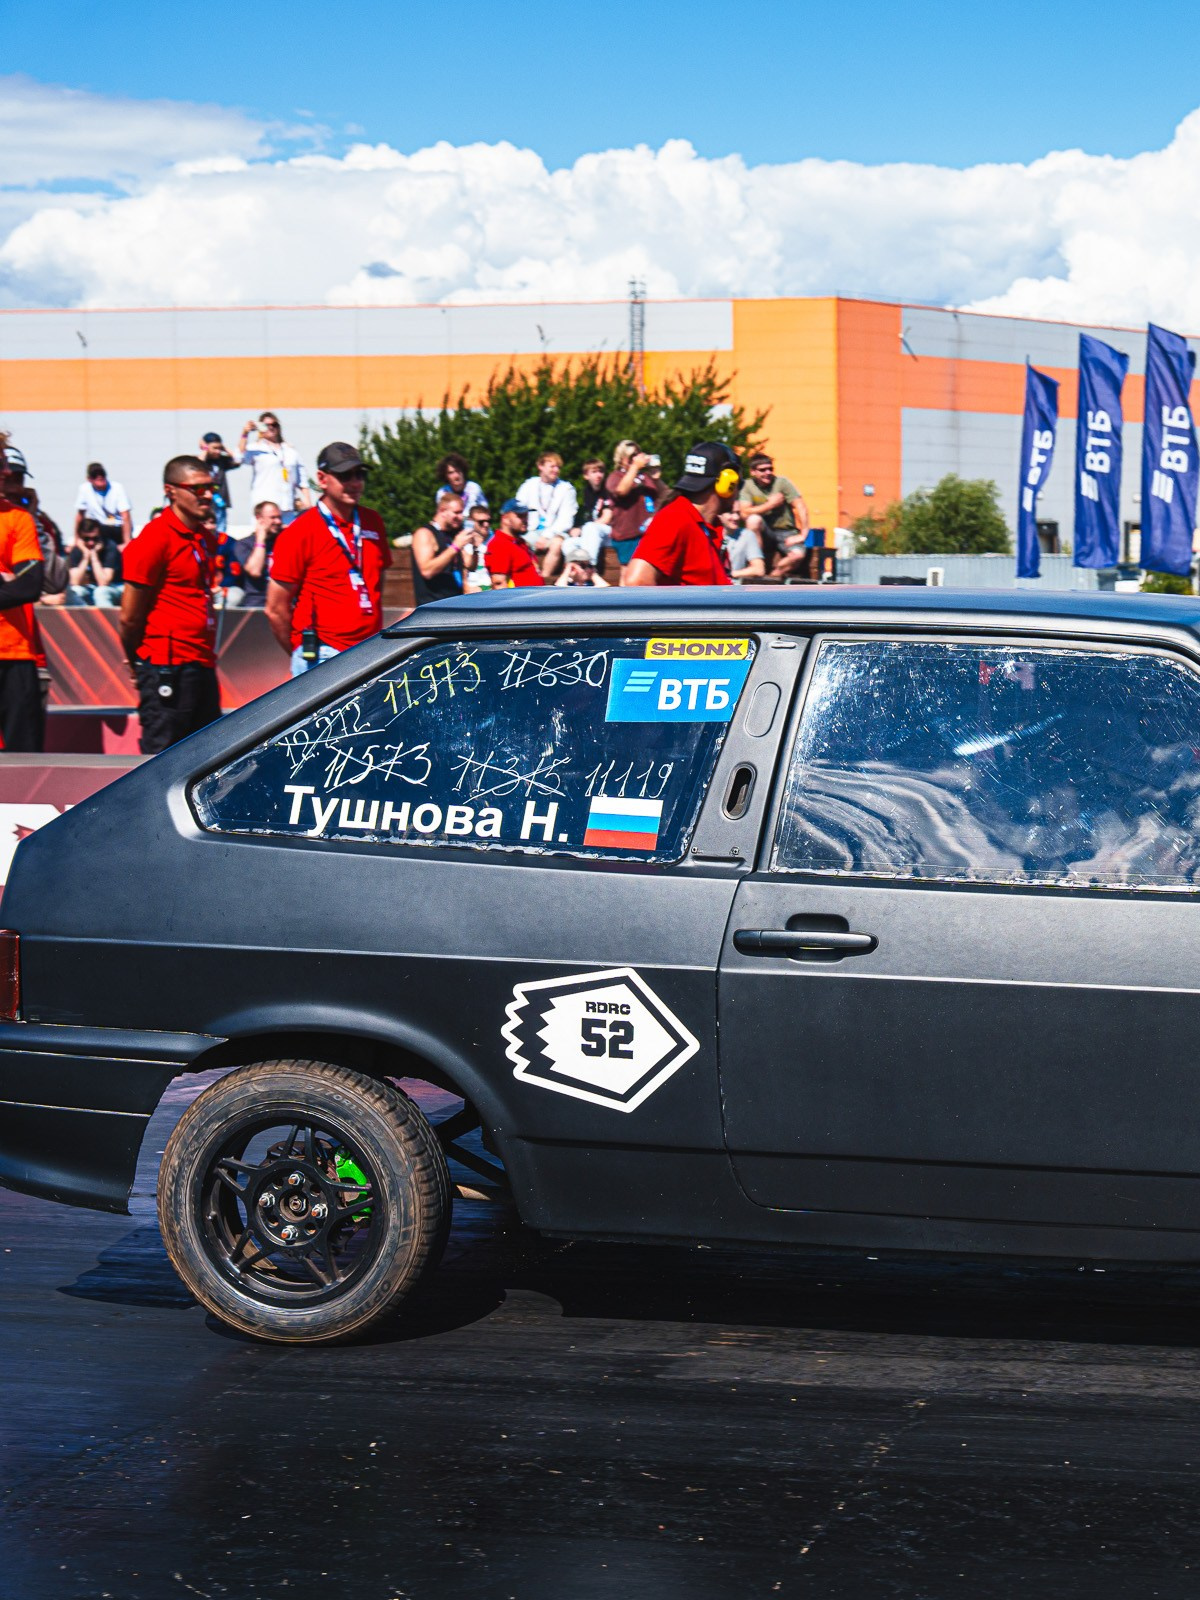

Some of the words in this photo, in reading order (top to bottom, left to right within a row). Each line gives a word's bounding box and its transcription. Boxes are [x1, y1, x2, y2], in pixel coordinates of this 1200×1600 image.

[1085, 410, 1112, 474] ВТБ
[1160, 405, 1190, 473] ВТБ
[650, 642, 744, 656] SHONX
[657, 678, 730, 711] ВТБ
[283, 784, 504, 838] Тушнова
[519, 800, 569, 843] Н.
[585, 1000, 631, 1016] RDRC
[580, 1017, 635, 1060] 52
